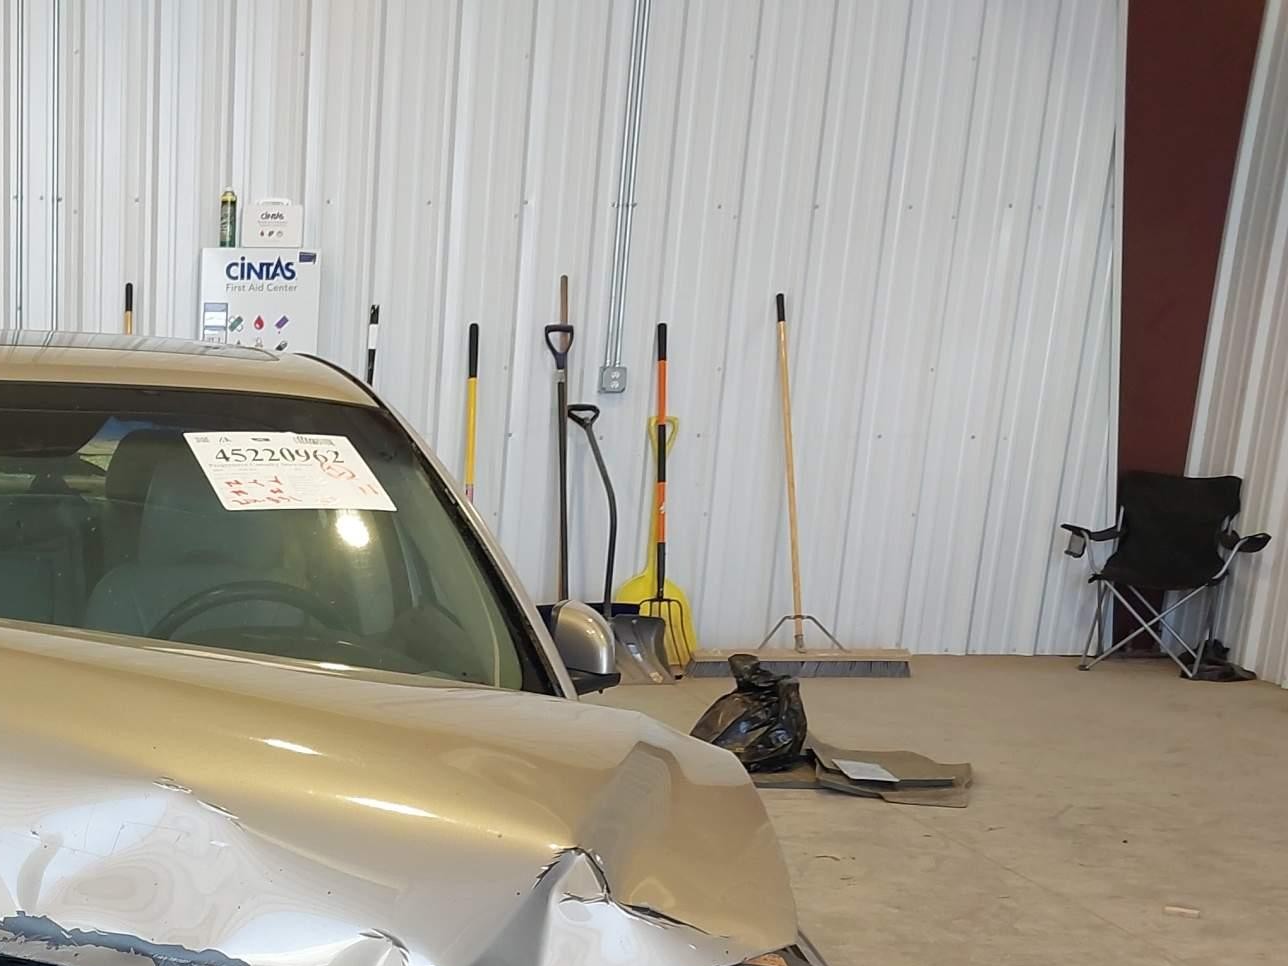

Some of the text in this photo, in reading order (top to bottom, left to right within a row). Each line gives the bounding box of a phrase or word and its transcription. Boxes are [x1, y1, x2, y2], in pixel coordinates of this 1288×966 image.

[225, 282, 298, 293] First Aid Center
[215, 447, 345, 465] 45220962
